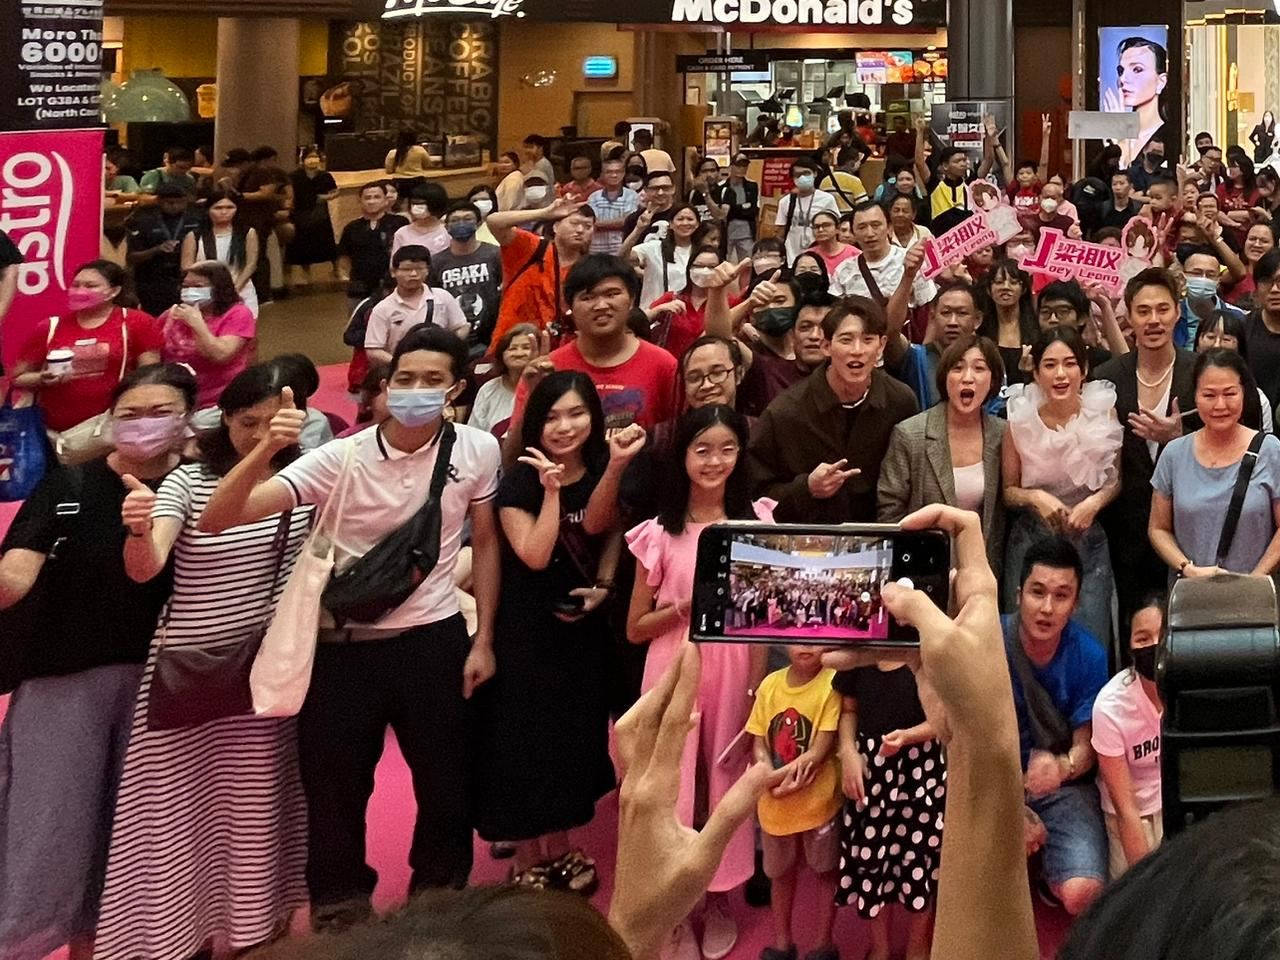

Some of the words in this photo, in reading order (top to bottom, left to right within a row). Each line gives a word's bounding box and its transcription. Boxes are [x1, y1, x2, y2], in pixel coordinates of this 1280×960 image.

[22, 28, 77, 41] More
[17, 97, 45, 106] LOT
[0, 152, 52, 295] astro
[442, 263, 489, 283] OSAKA
[1079, 269, 1119, 286] Leong
